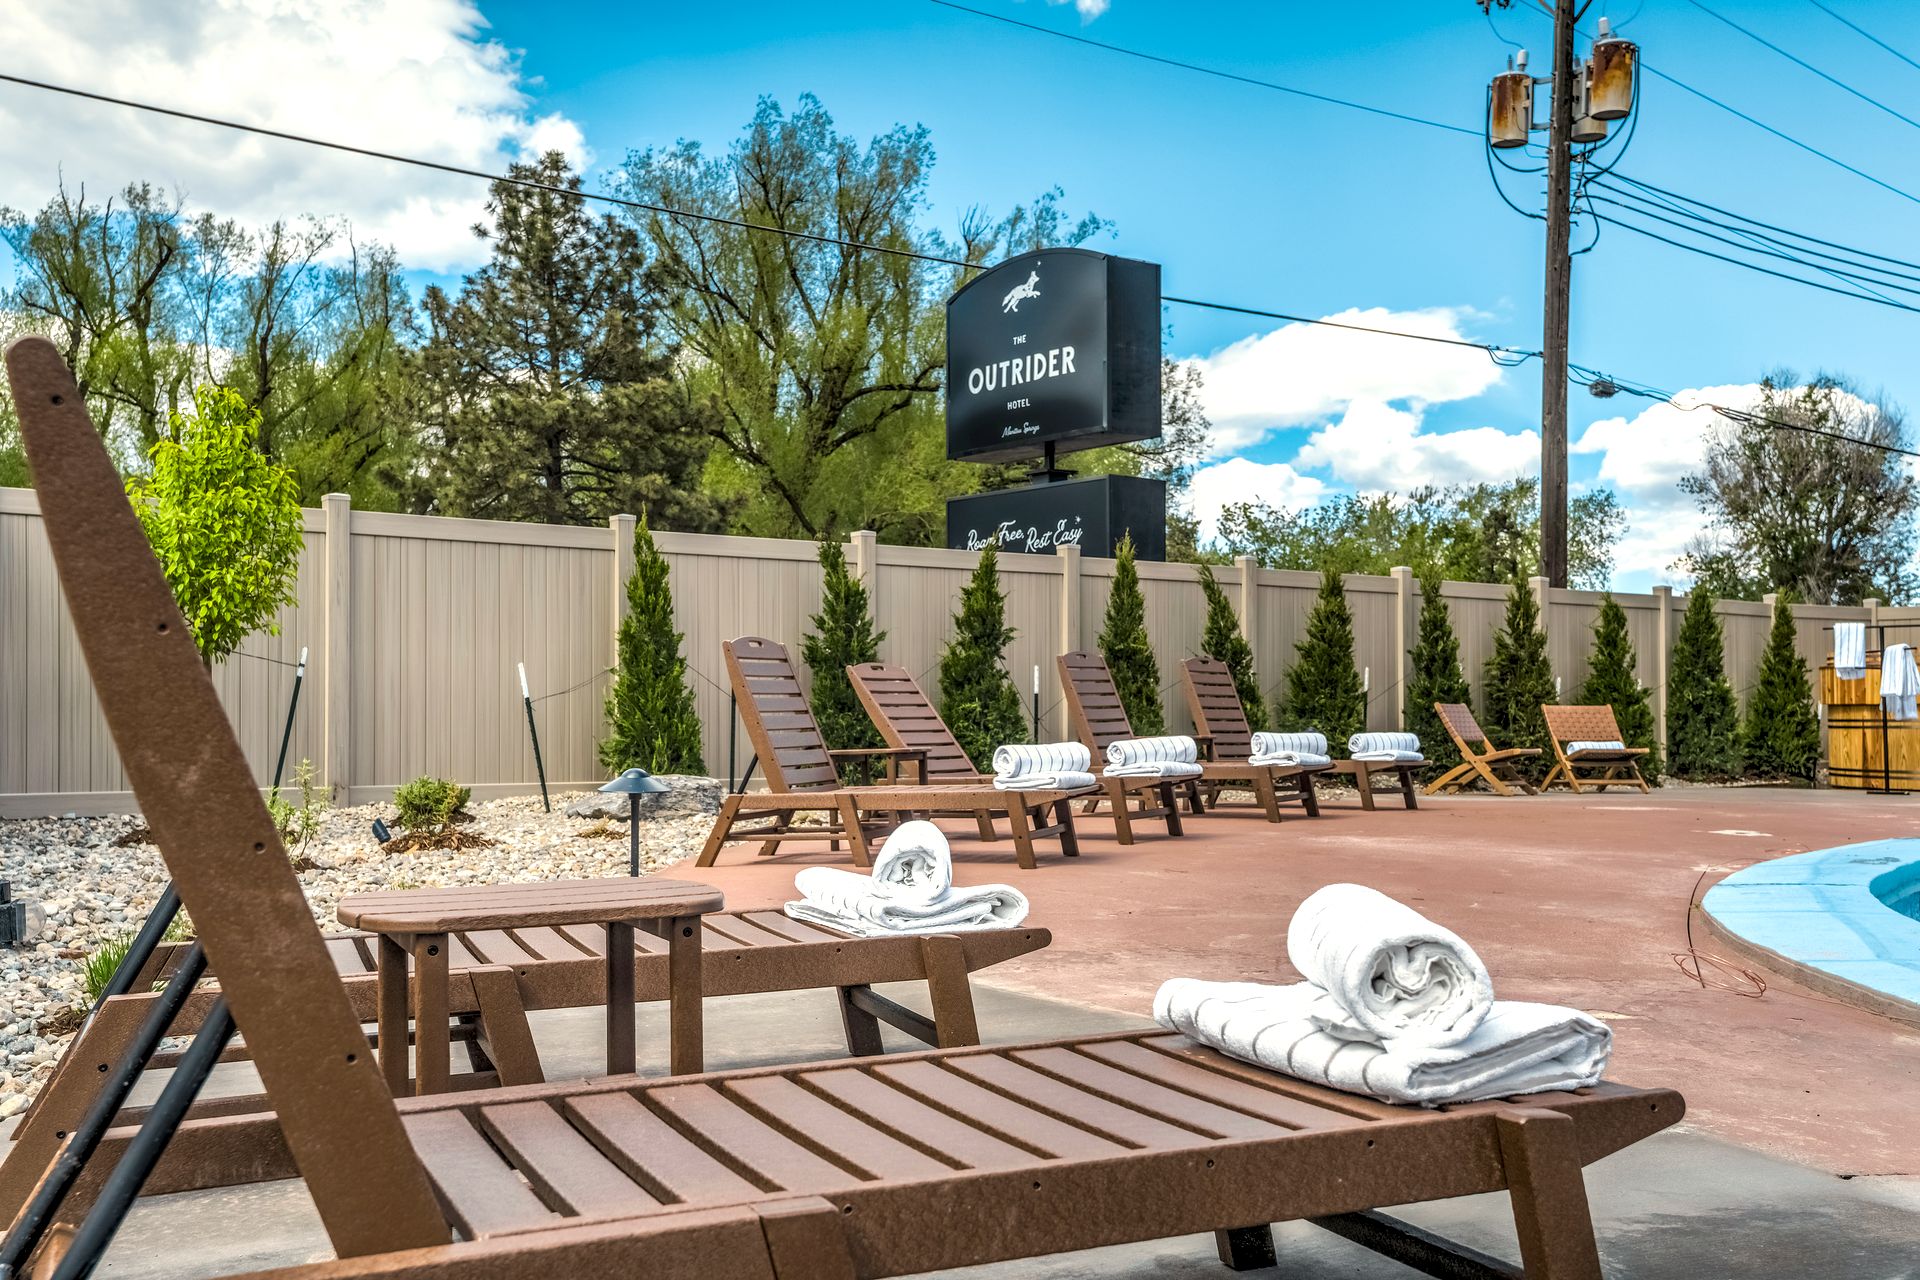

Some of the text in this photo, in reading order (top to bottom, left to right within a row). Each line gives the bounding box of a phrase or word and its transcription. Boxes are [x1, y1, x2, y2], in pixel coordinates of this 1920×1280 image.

[1013, 334, 1027, 345] THE
[968, 346, 1076, 394] OUTRIDER
[1007, 398, 1031, 410] HOTEL
[1024, 527, 1053, 553] Rest
[1052, 519, 1083, 546] Easy
